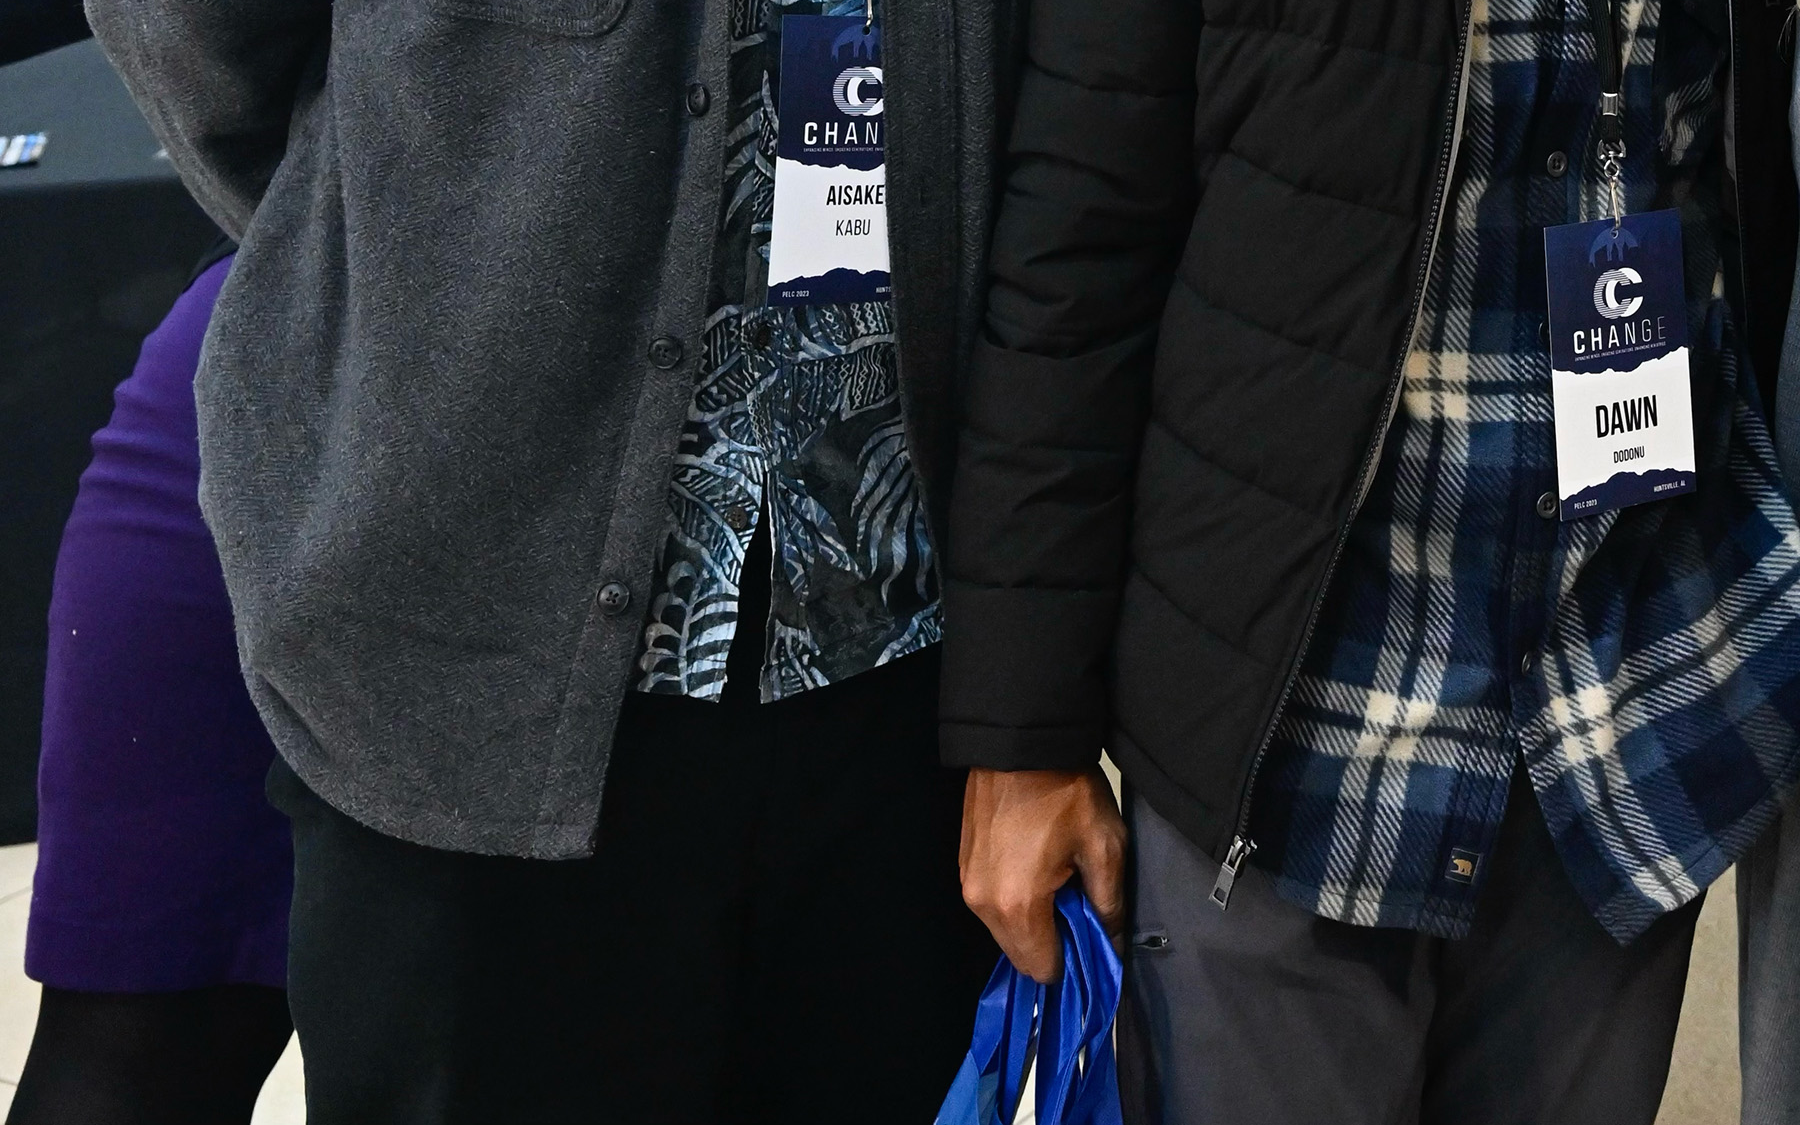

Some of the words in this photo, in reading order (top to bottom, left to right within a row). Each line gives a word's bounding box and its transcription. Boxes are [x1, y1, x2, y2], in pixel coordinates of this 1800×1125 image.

[826, 185, 885, 206] AISAKE
[835, 219, 871, 236] KABU
[1573, 316, 1666, 354] CHANGE
[1595, 394, 1658, 438] DAWN
[1613, 445, 1645, 464] DODONU
